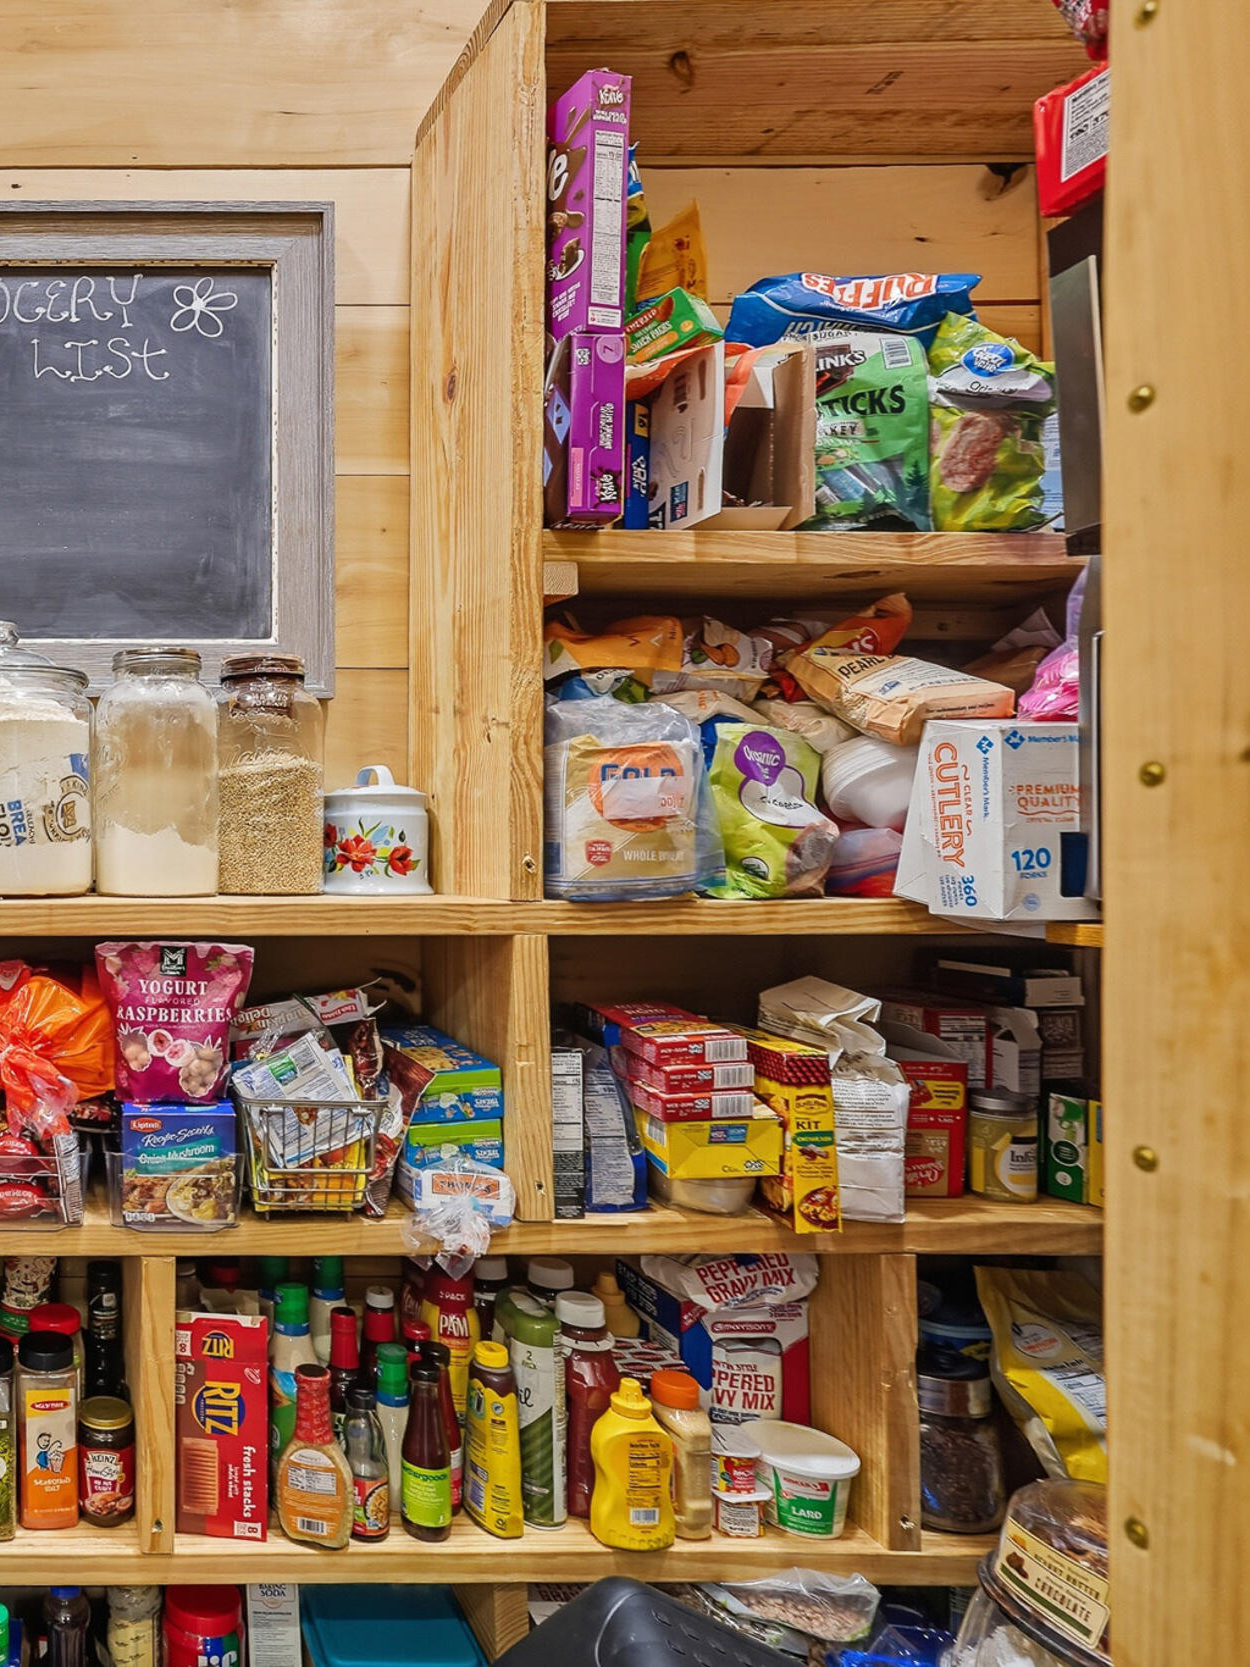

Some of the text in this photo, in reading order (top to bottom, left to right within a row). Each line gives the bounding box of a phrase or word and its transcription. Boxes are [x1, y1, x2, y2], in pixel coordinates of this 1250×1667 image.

[932, 742, 966, 868] CUTLERY
[962, 785, 974, 820] CLEAR
[7, 800, 29, 847] BREA
[623, 850, 657, 862] WHOLE
[1011, 848, 1052, 871] 120
[961, 875, 978, 908] 360
[138, 979, 208, 996] YOGURT
[116, 1006, 233, 1024] RASPBERRIES
[230, 1007, 271, 1027] Deligh
[131, 1118, 161, 1131] Lipton
[796, 1121, 822, 1130] KIT
[167, 1144, 215, 1161] Mushroom
[696, 1254, 790, 1285] PEPPRED
[706, 1268, 797, 1303] GRAVY MIX
[439, 1311, 470, 1338] PAM
[201, 1335, 234, 1359] RITZ
[712, 1370, 776, 1392] PERED
[204, 1380, 242, 1437] RITZ
[742, 1391, 776, 1411] MIX
[90, 1453, 116, 1464] HEINZ
[242, 1445, 257, 1518] fresh stacks
[791, 1507, 823, 1520] LARD
[260, 1589, 287, 1598] SODA
[1034, 1577, 1092, 1623] CHOCOLATE
